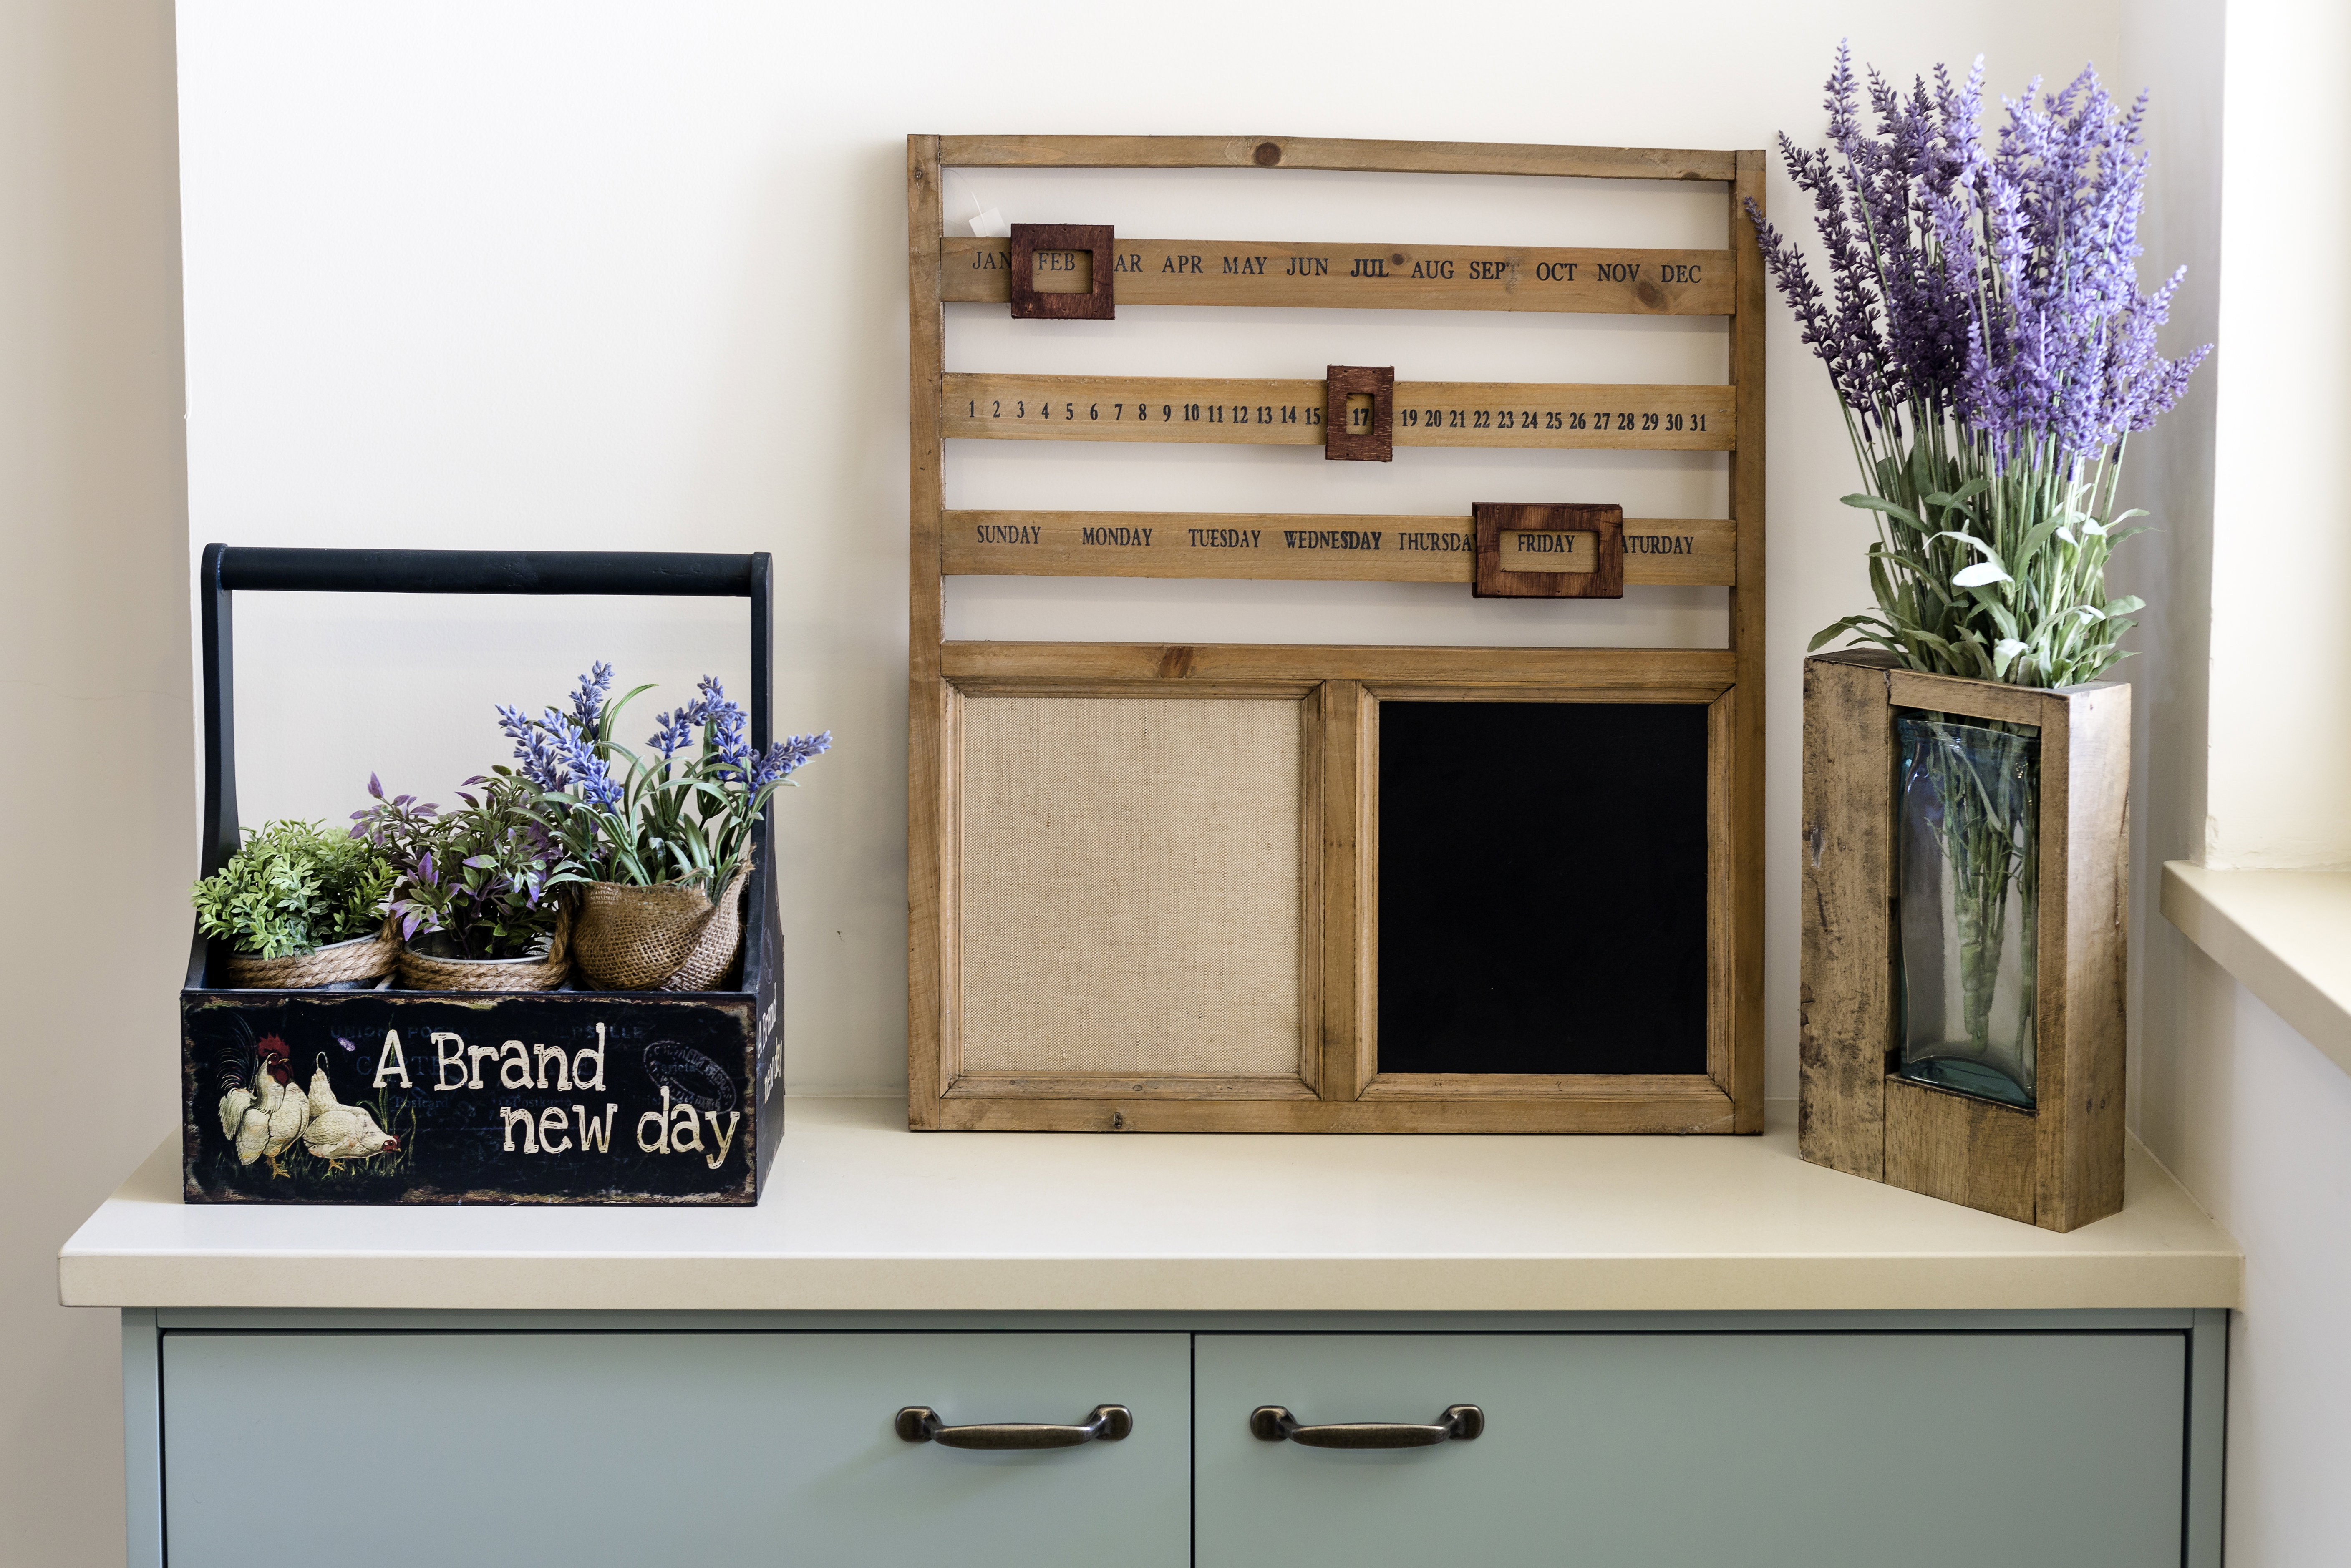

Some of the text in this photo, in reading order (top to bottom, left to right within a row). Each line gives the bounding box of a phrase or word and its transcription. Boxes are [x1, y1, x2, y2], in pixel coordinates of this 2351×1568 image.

[972, 252, 1011, 269] JAN
[1038, 252, 1076, 271] FEB
[1114, 254, 1143, 272] AR
[1162, 255, 1204, 273] APR
[1223, 256, 1268, 275] MAY
[1286, 257, 1329, 276] JUN
[1350, 258, 1389, 278] JUL
[1411, 260, 1454, 279] AUG
[1536, 262, 1577, 281] OCT
[1597, 263, 1640, 282] NOV
[1661, 264, 1701, 284] DEC
[969, 400, 1707, 432] 1 2 3 4 5 6 7 8 9 10 11 12 13 14 15 17 19 20 21 22 23 24 25 26 27 28 29 30 31
[977, 525, 1041, 544] SUNDAY
[1082, 527, 1153, 546] MONDAY
[1188, 529, 1261, 548] TUESDAY
[1283, 530, 1382, 550] WEDNESDAY
[1517, 534, 1575, 554] FRIDAY
[1622, 535, 1694, 554] ATURDAY
[372, 1029, 413, 1088] A
[430, 1022, 606, 1092] Brand
[500, 1085, 740, 1169] new day
